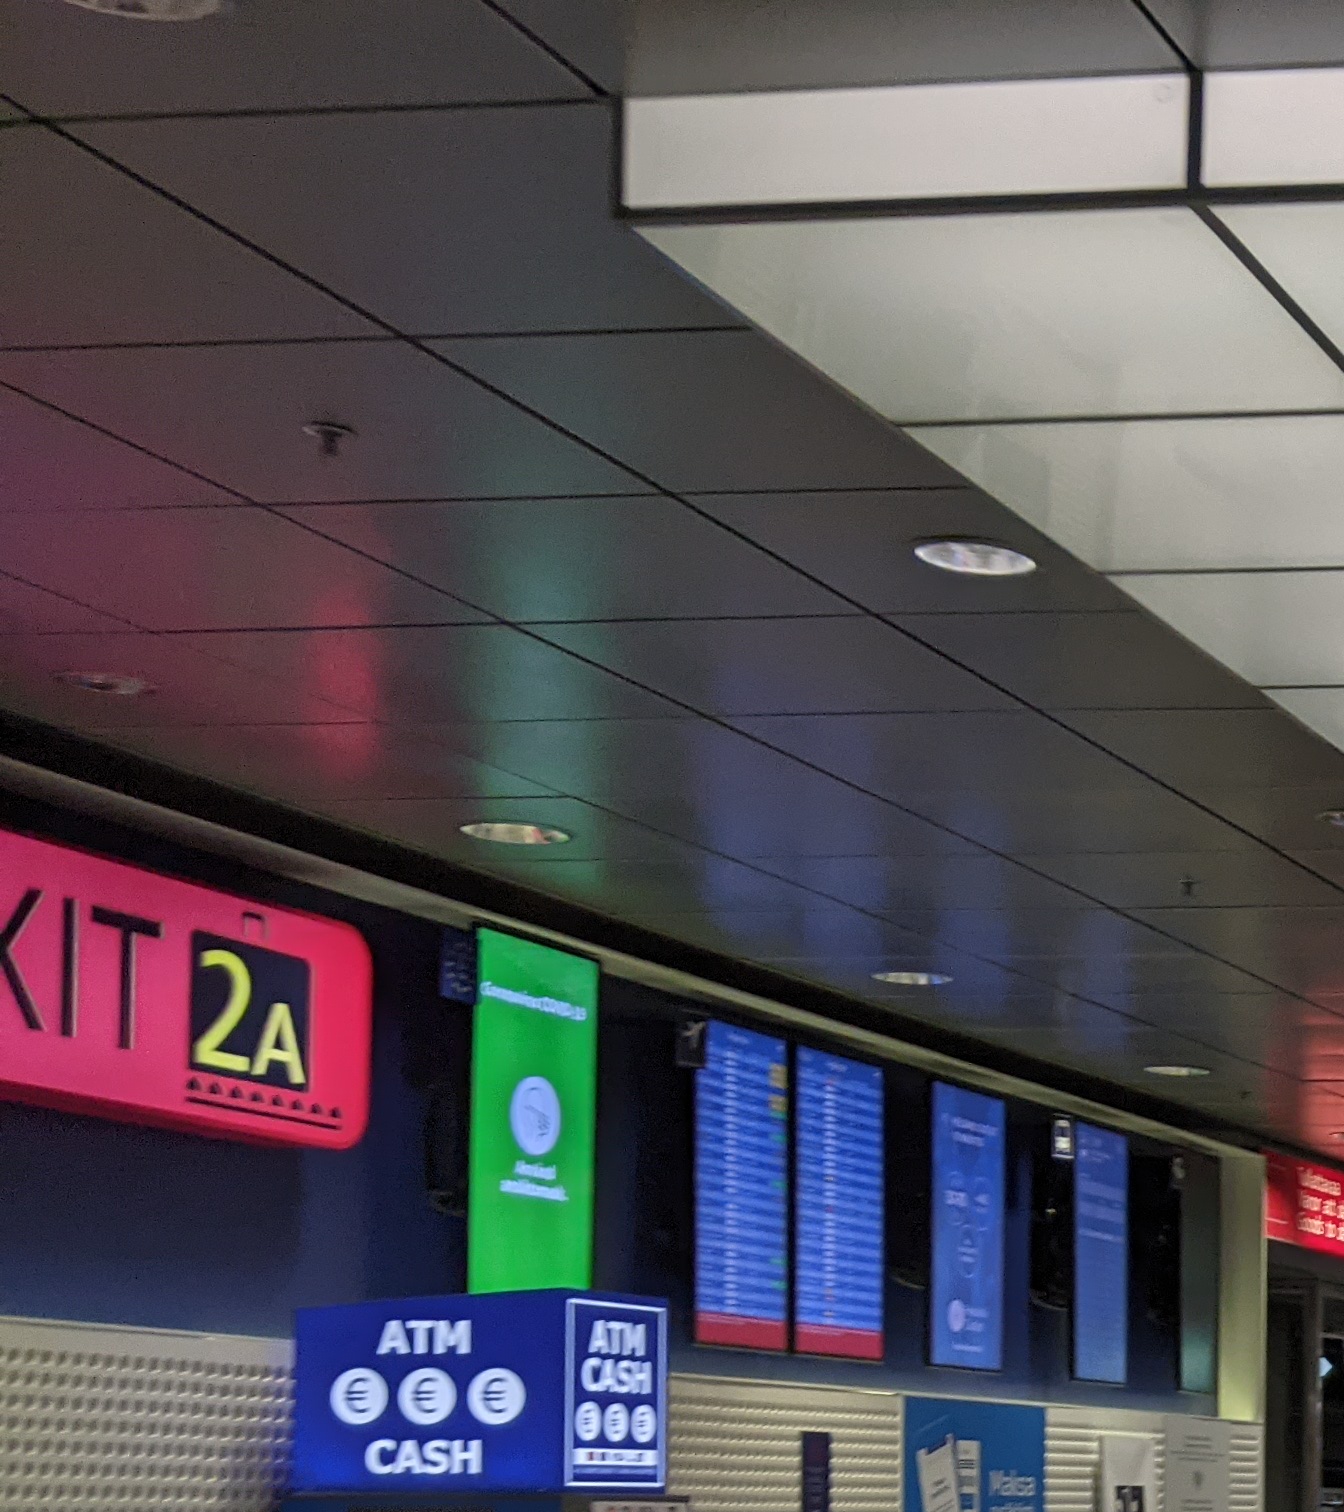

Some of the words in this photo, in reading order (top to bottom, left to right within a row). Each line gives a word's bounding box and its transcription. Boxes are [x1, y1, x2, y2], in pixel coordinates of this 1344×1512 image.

[194, 949, 306, 1084] 2A
[376, 1319, 473, 1355] ATM
[588, 1320, 647, 1357] ATM
[581, 1357, 653, 1395] CASH
[364, 1438, 483, 1475] CASH
